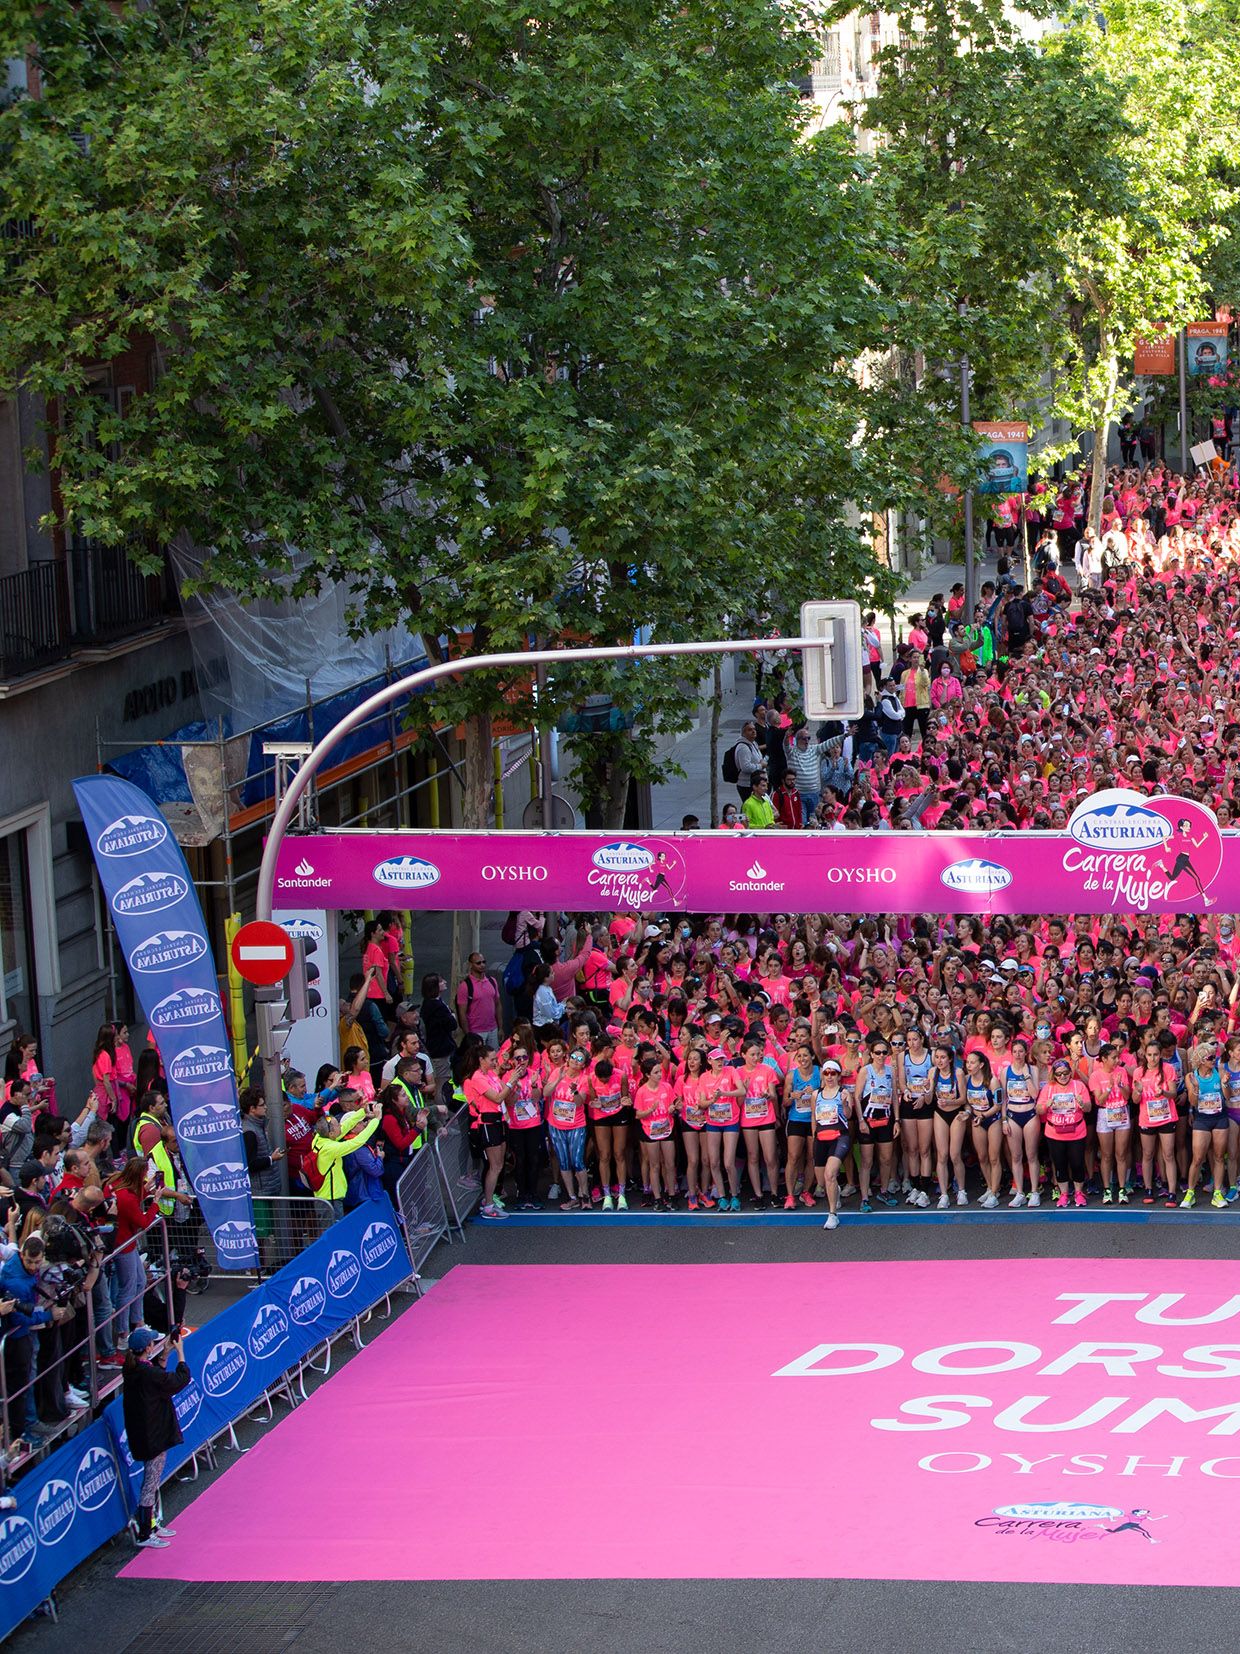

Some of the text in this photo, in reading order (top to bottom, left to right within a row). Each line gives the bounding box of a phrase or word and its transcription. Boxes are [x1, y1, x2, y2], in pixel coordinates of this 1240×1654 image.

[1079, 821, 1164, 838] ASTURIANA
[597, 853, 650, 865] ASTURIANA
[1062, 847, 1147, 872] Carrera
[379, 867, 435, 880] ASTURIANA
[481, 865, 548, 881] OYSHO
[587, 869, 638, 885] Carrera
[827, 867, 897, 883] OYSHO
[947, 871, 1006, 884] ASTURIANA
[277, 878, 332, 888] Santander
[729, 880, 784, 891] Santander
[1083, 869, 1178, 911] de la Mujer
[600, 883, 658, 909] de la Mujer
[363, 1235, 396, 1265] ASTURIANA
[206, 1354, 245, 1392] ASTURIANA
[79, 1466, 116, 1504] ASTURIANA
[38, 1497, 74, 1539] ASTURIANA
[1004, 1507, 1112, 1517] ASTURIANA
[974, 1517, 1083, 1529] Carrera
[995, 1527, 1015, 1535] de
[1030, 1527, 1111, 1544] Mujer
